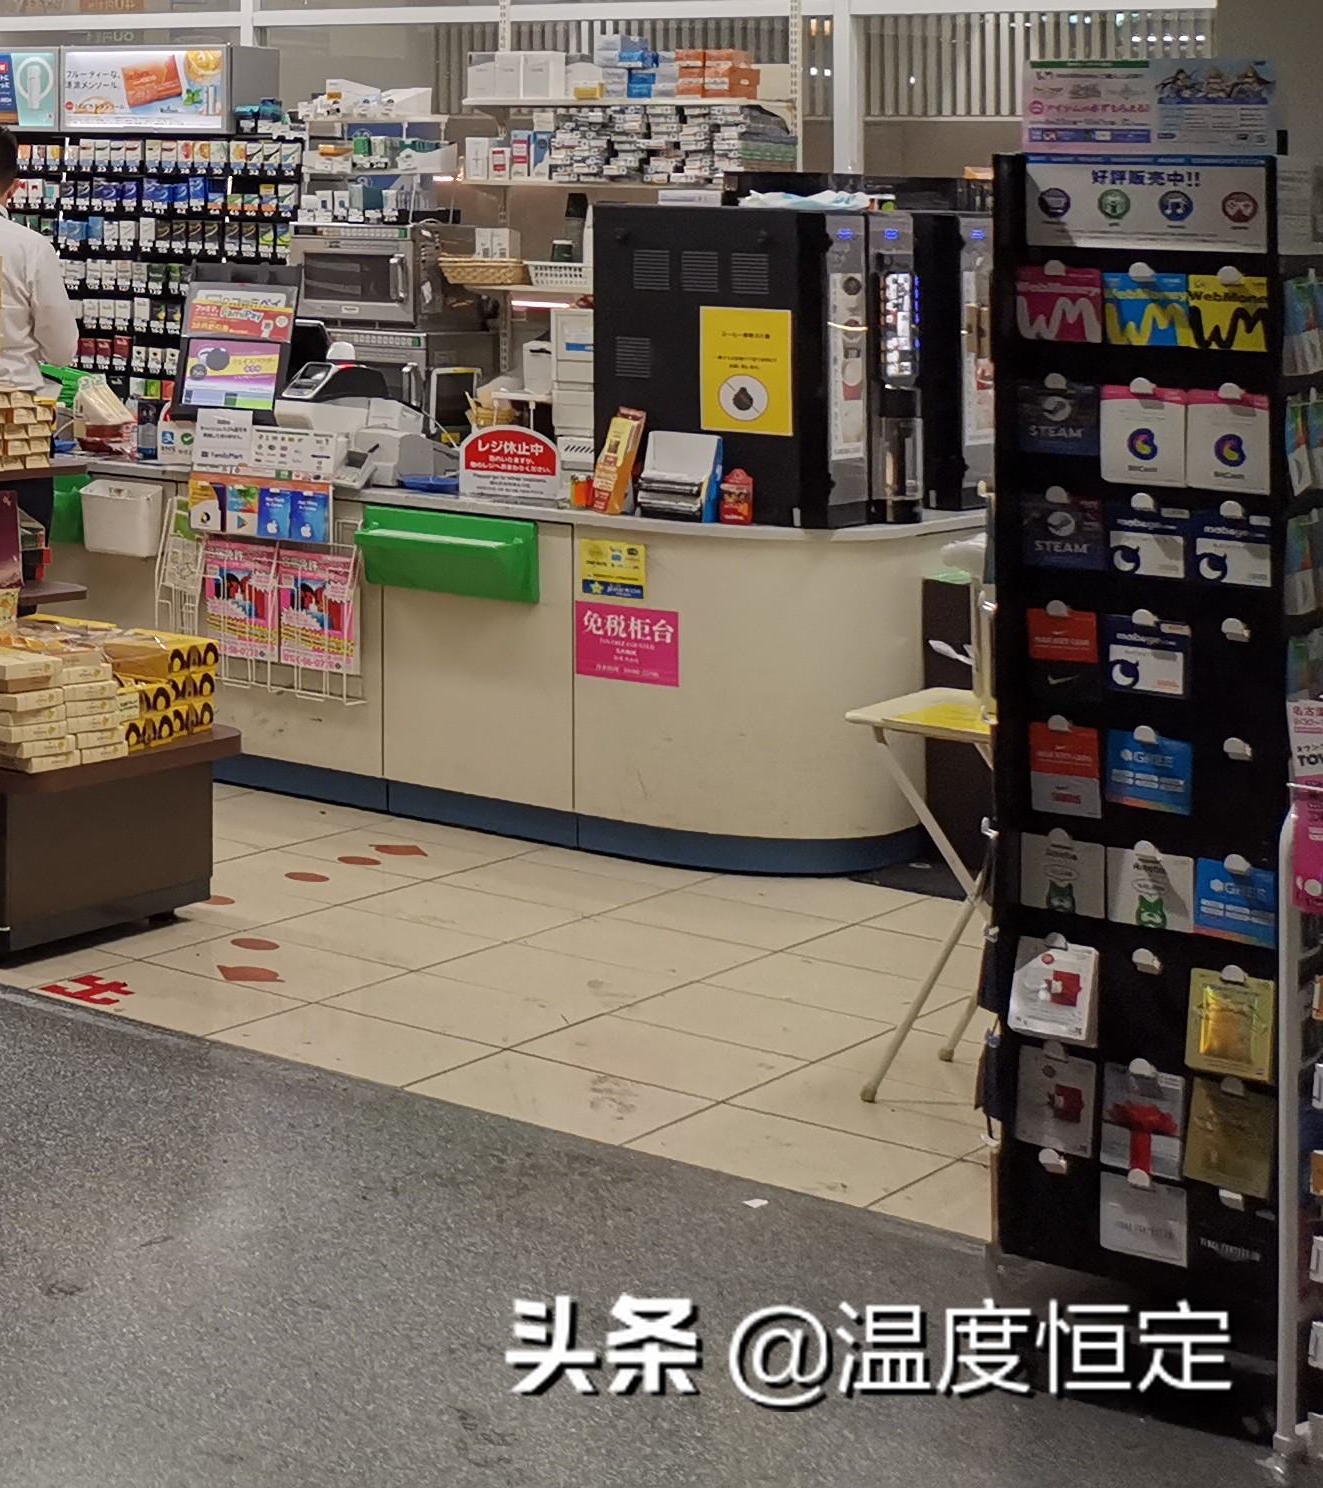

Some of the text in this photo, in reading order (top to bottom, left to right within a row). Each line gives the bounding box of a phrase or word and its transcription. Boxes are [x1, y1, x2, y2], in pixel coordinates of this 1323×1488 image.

[1027, 424, 1083, 438] STEAM
[477, 439, 544, 456] レジ休止中
[1034, 539, 1089, 554] STEAM
[583, 609, 675, 644] 免税柜台
